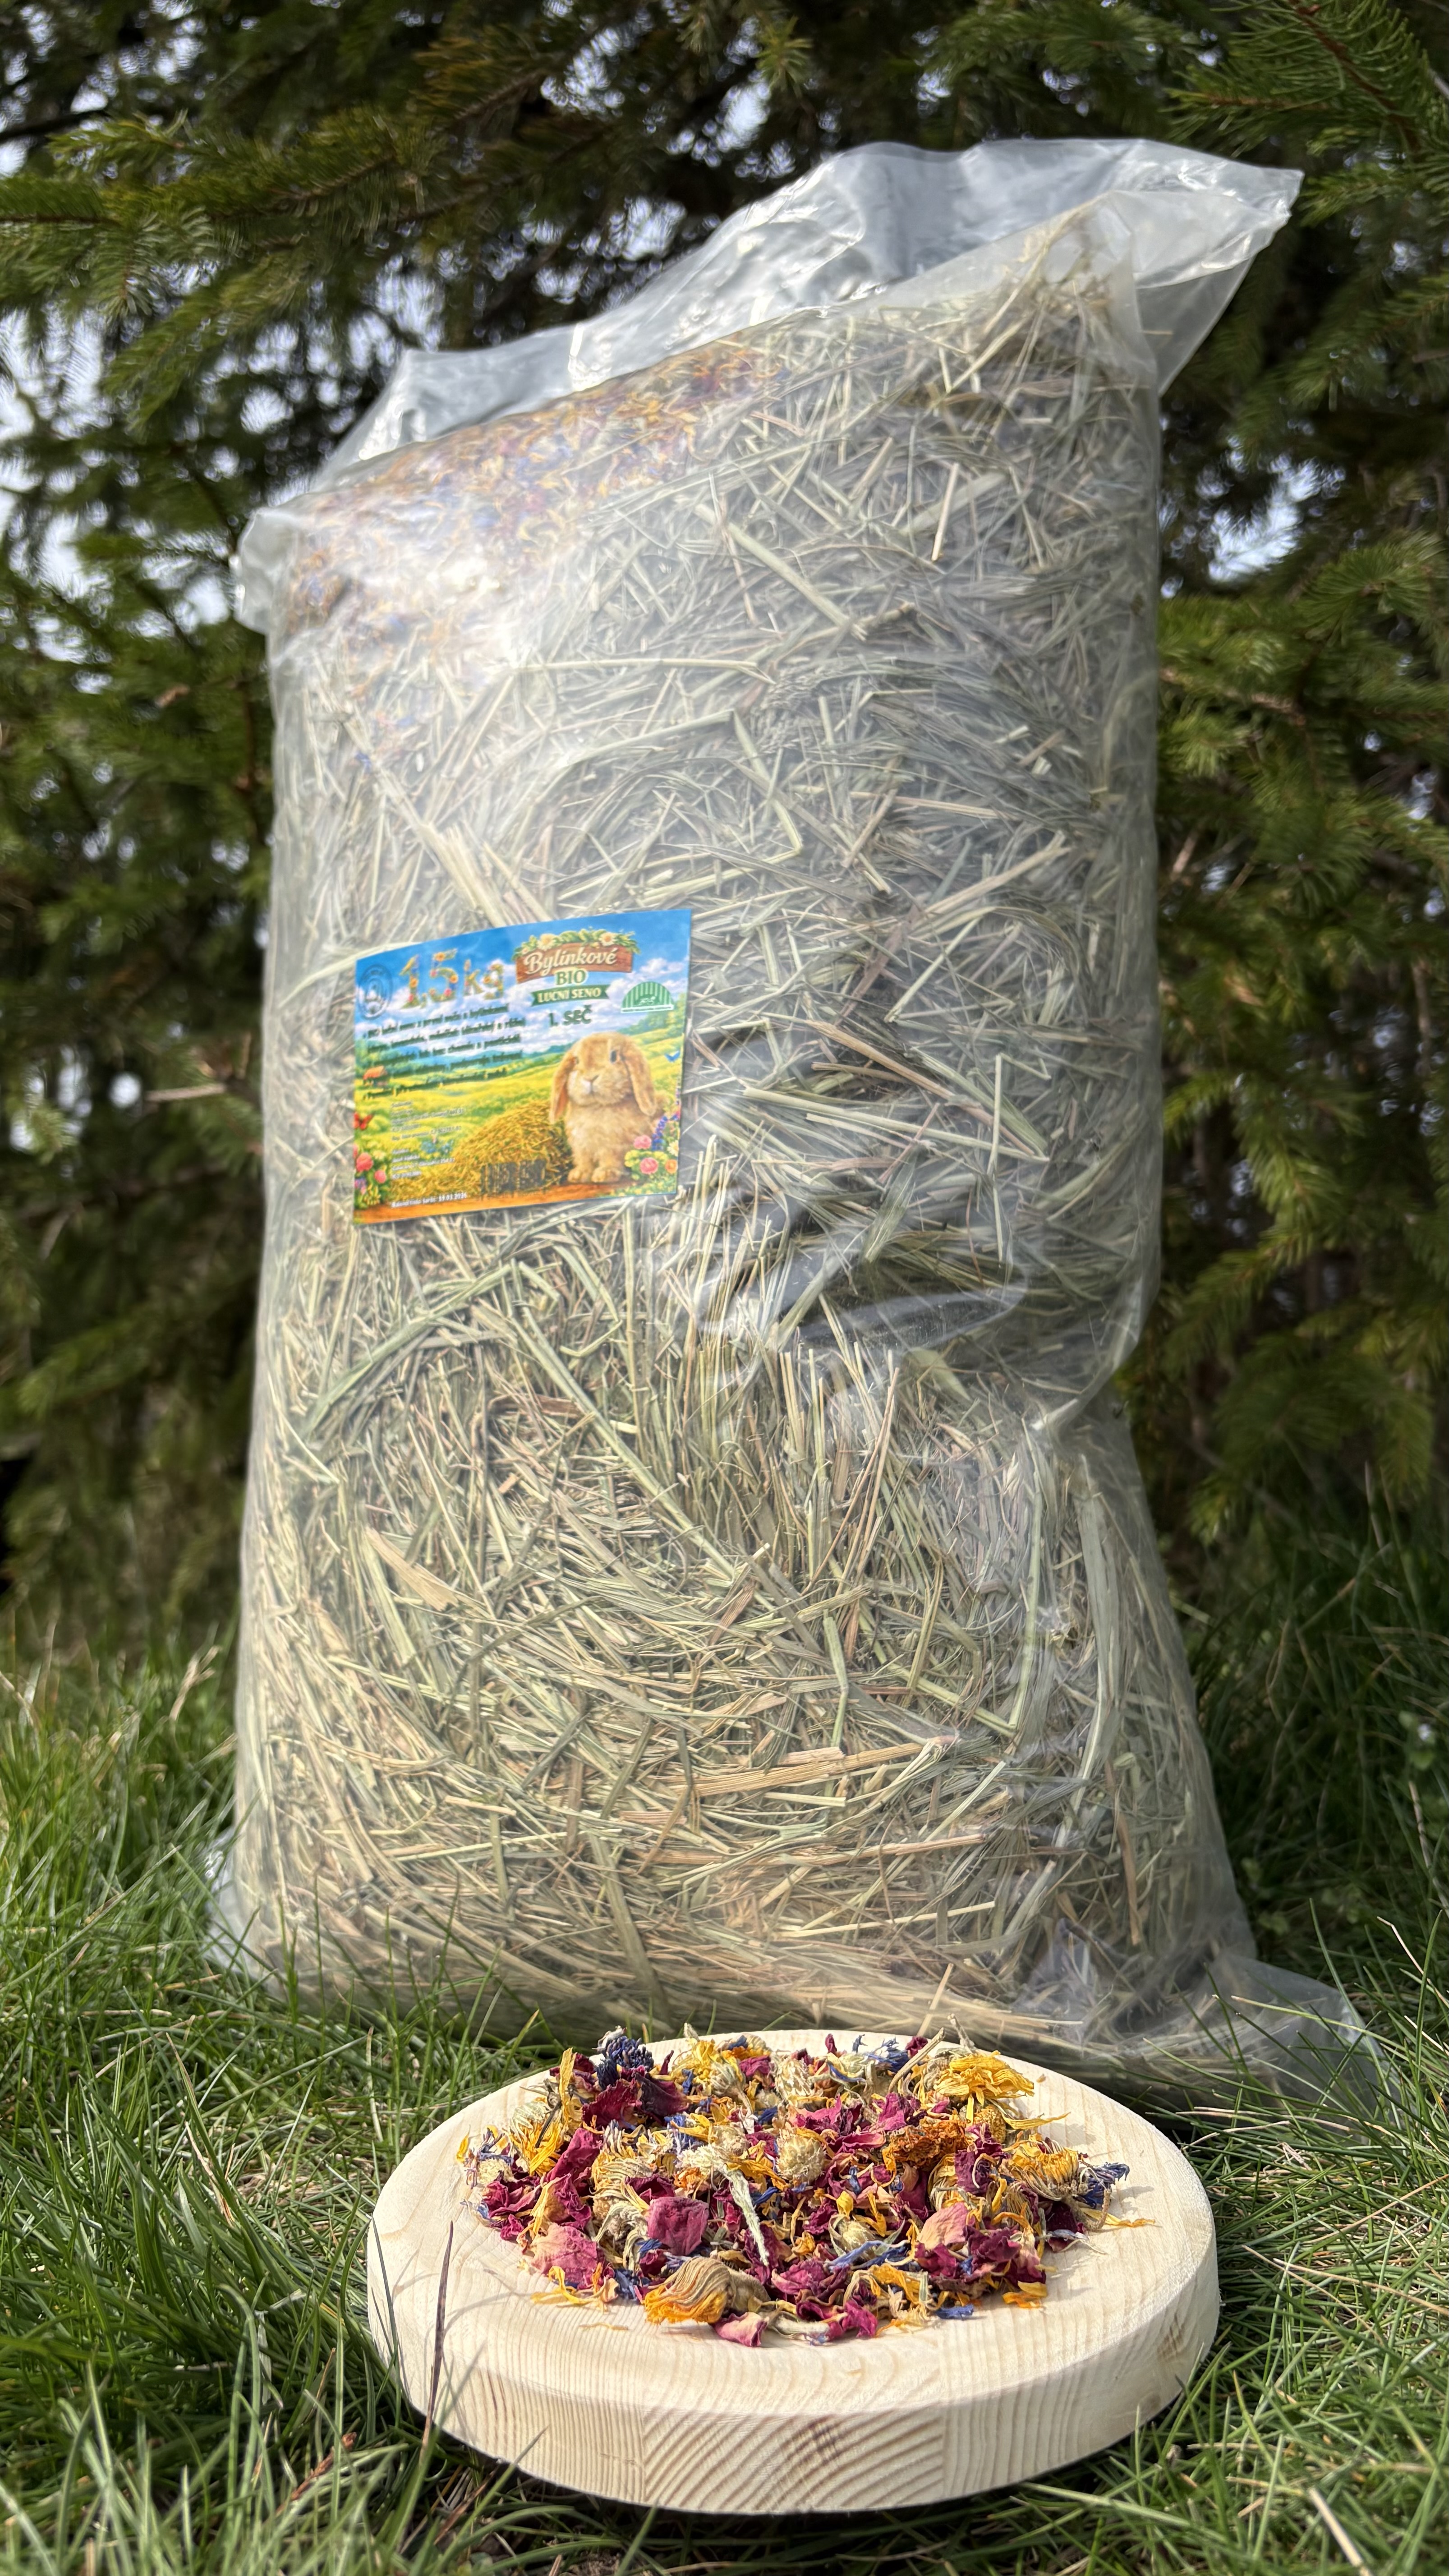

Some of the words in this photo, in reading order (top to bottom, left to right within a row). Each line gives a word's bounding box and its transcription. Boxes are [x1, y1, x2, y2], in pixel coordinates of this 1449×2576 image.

[524, 948, 618, 976] Bylinkové
[400, 948, 458, 1009] 1,5
[463, 959, 504, 1000] kg
[556, 970, 586, 985] BIO
[571, 987, 602, 999] SENO
[548, 1012, 559, 1027] 1.
[562, 1005, 592, 1026] SEČ
